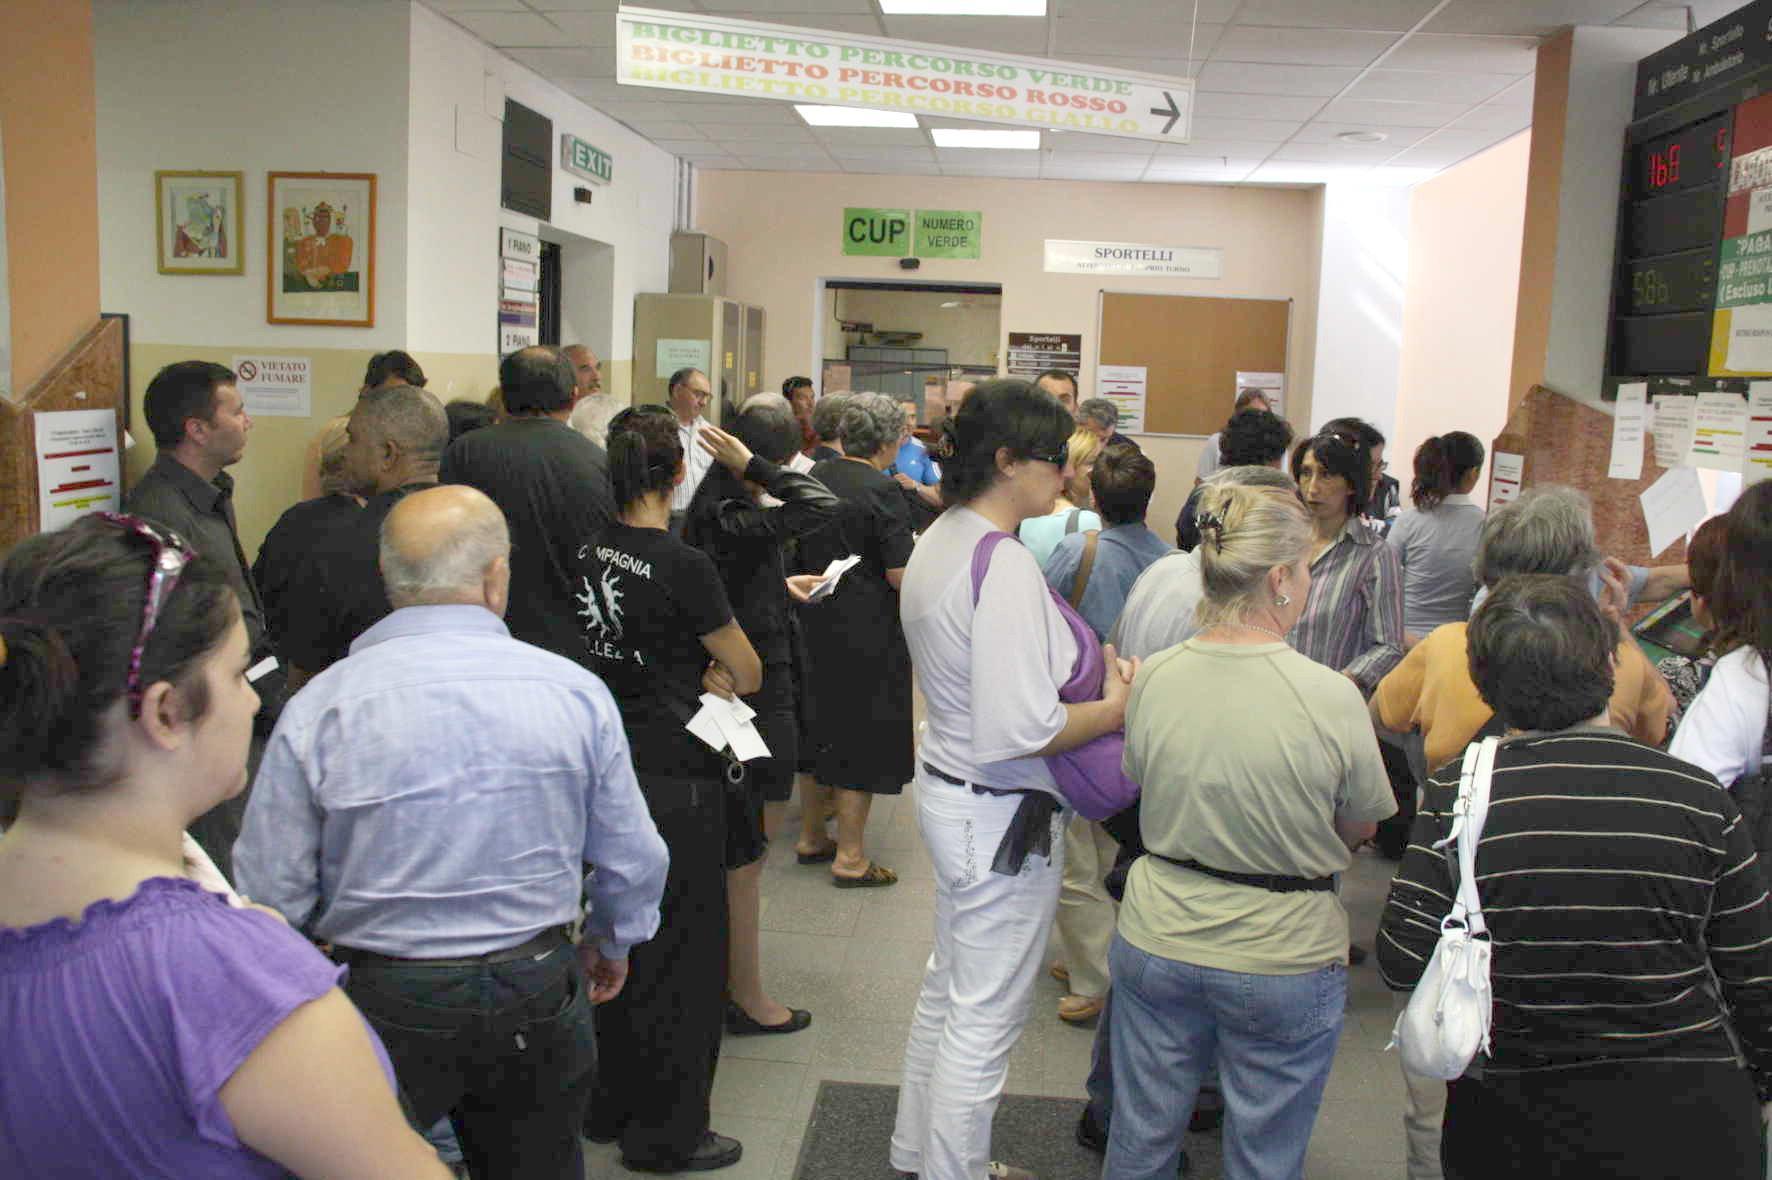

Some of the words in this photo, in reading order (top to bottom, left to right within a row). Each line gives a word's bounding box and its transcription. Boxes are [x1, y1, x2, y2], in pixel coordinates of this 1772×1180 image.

[631, 22, 829, 58] BIGLIETTO
[839, 46, 1018, 80] PERCORSO
[1026, 68, 1133, 96] VERDE
[631, 44, 829, 79] BIGLIETTO
[838, 67, 1017, 100] PERCORSO
[1026, 88, 1127, 114] ROSSO
[630, 66, 828, 98] BIGLIETTO
[838, 87, 1017, 118] PERCORSO
[1025, 107, 1140, 134] GIALLO
[575, 142, 612, 178] EXIT
[849, 217, 905, 244] CUP
[922, 217, 975, 231] NUMERO
[927, 235, 968, 248] VERDE
[1094, 247, 1174, 262] SPORTELLI
[260, 360, 307, 372] VIETATO
[261, 372, 305, 385] FUMARE
[577, 544, 652, 580] CMPAGNIA
